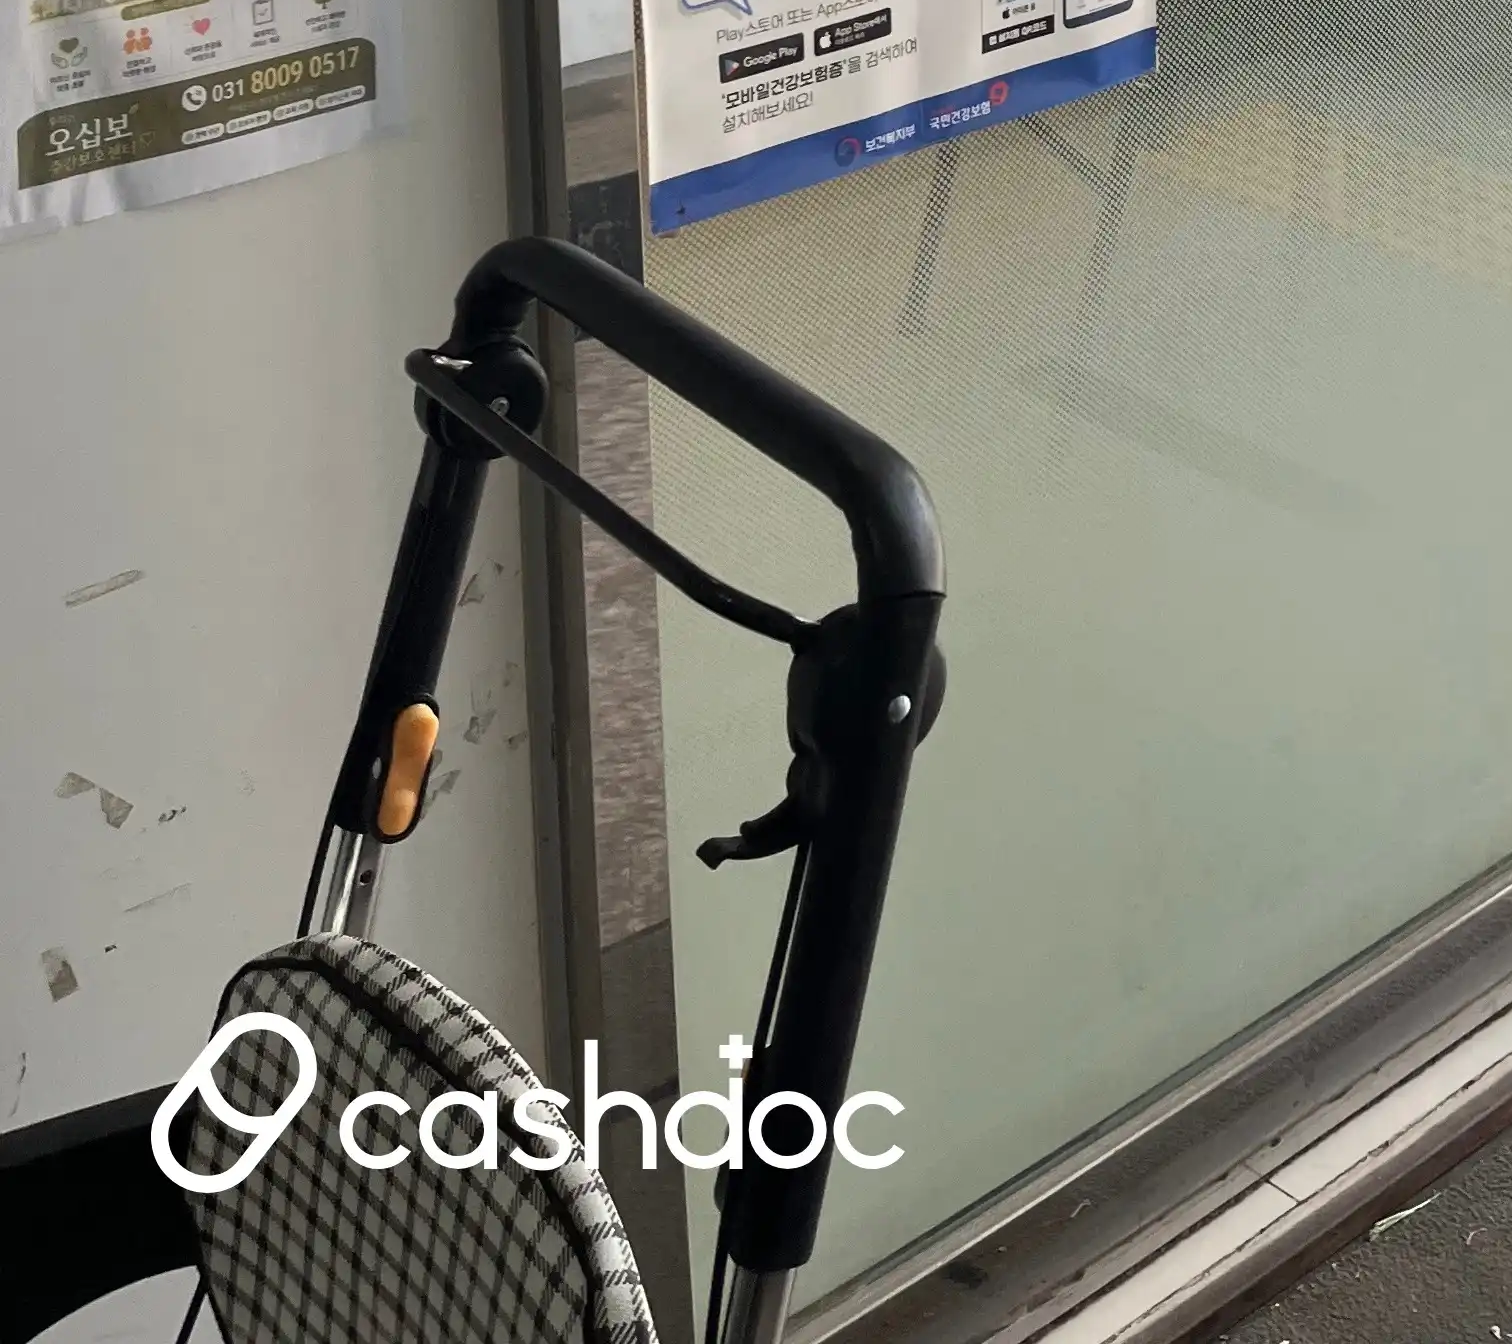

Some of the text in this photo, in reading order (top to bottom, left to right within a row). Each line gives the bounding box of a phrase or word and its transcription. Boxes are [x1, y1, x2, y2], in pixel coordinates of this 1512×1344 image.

[716, 14, 784, 45] Play스토어
[786, 6, 814, 26] 또는
[834, 22, 853, 40] App
[743, 44, 799, 69] Google Play
[864, 38, 919, 68] 검색하여
[212, 44, 361, 104] 031 8009 0517
[722, 89, 814, 134] 설치해보세요!
[928, 100, 993, 130] 국민건강보험
[44, 112, 134, 158] 오십보
[865, 123, 917, 153] 보건복지부
